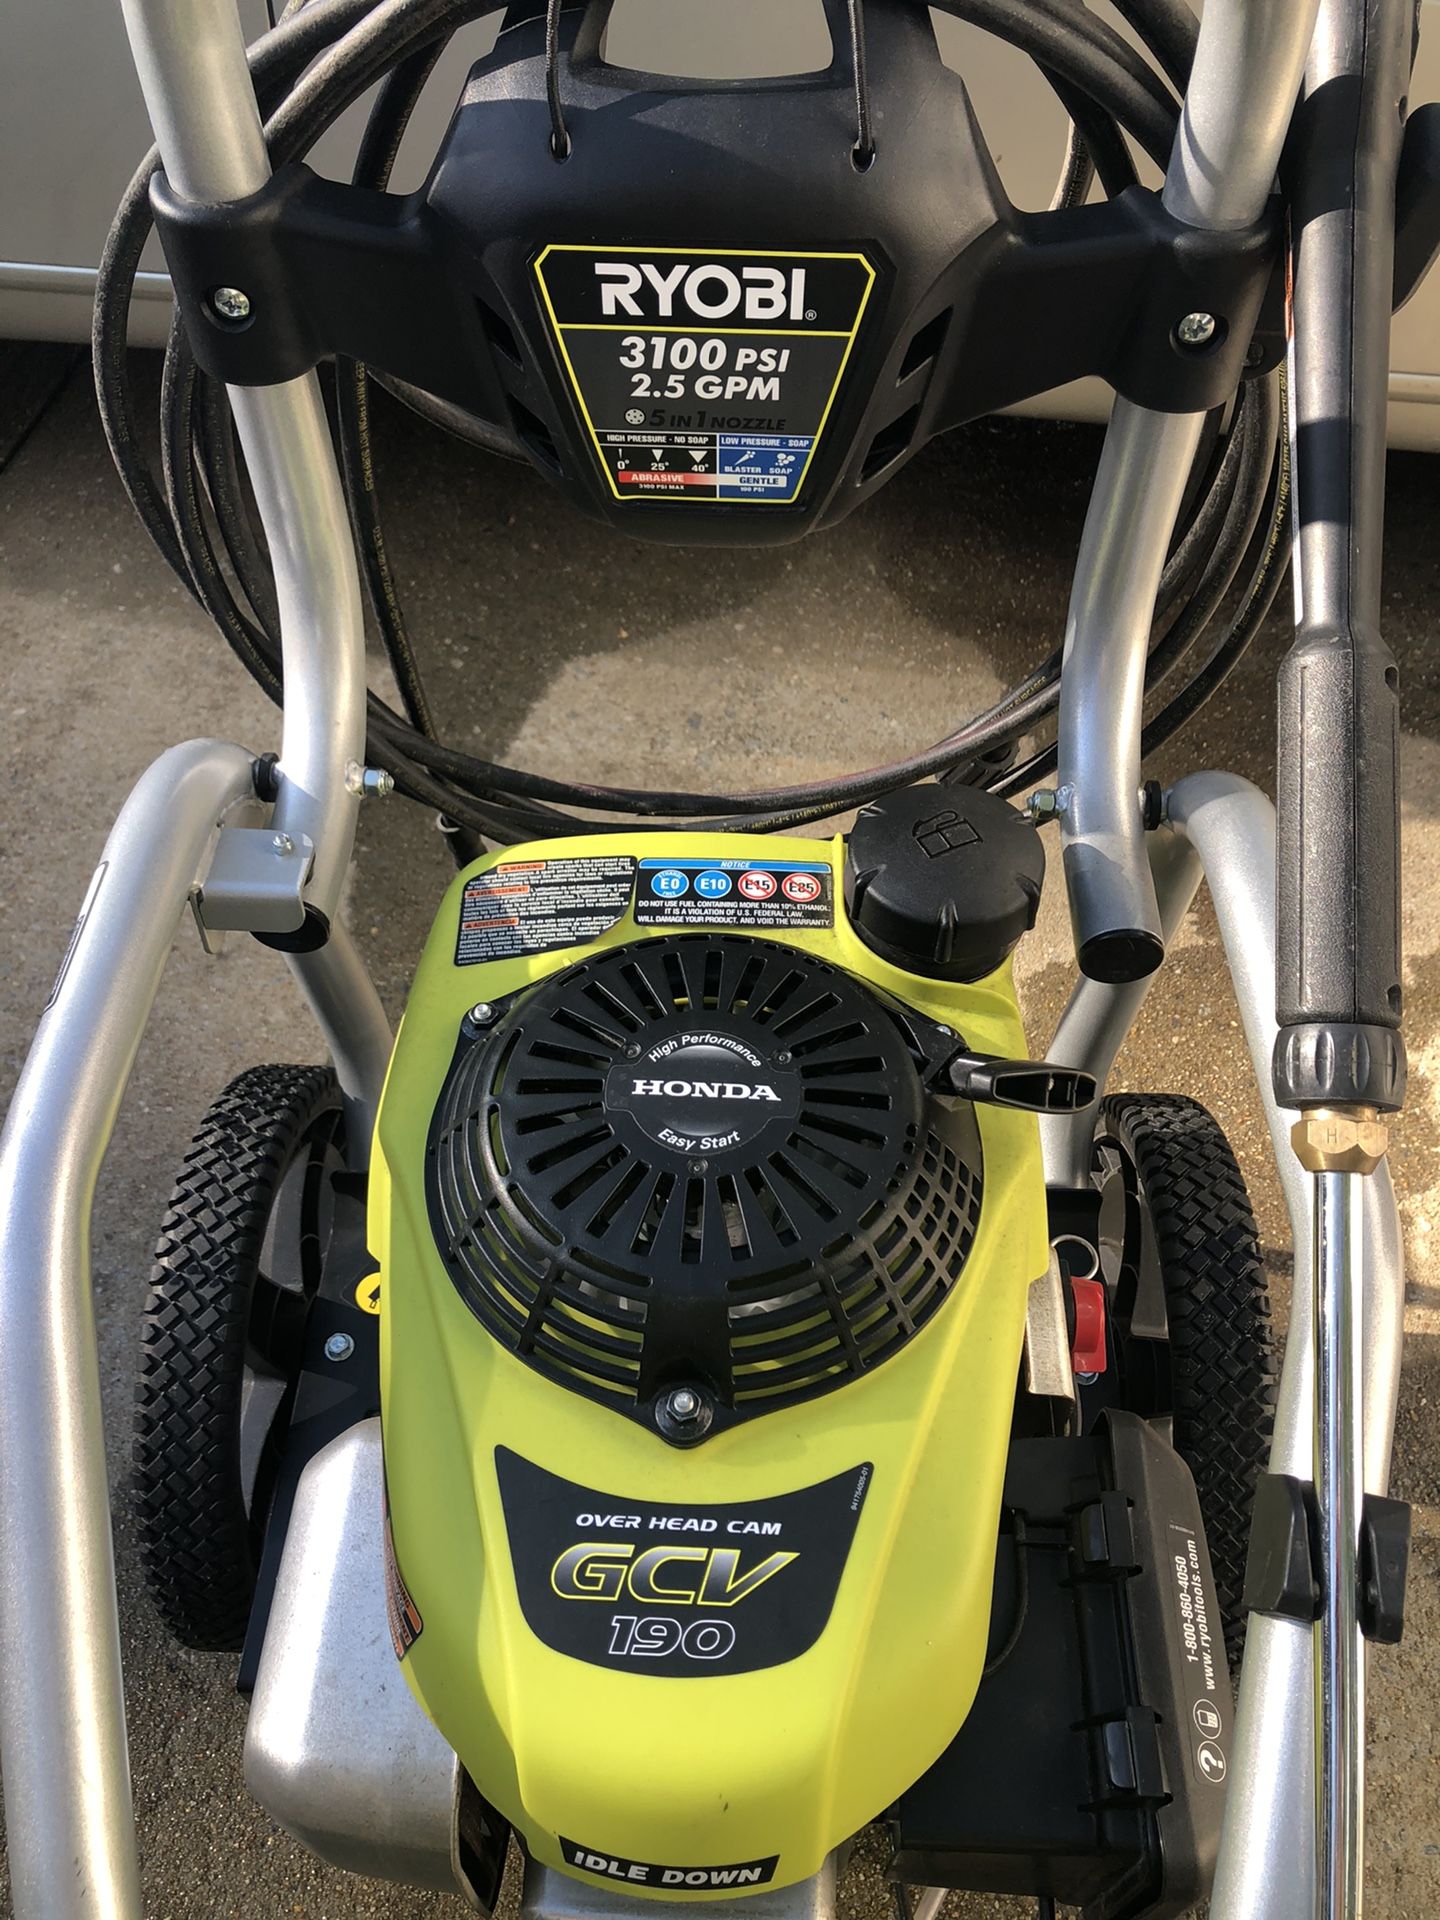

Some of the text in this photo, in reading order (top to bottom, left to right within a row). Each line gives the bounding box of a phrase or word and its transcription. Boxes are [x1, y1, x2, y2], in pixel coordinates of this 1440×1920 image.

[594, 262, 806, 320] RYOBI
[619, 335, 790, 373] 3100 PSI
[630, 373, 781, 401] 2.5 GPM
[650, 409, 786, 431] 5 IN 1 NOZZLE
[607, 434, 626, 442] HIGH
[628, 435, 667, 443] PRESSURE
[674, 436, 686, 444] NO
[688, 436, 709, 445] SOAP
[721, 437, 739, 445] LOW
[741, 437, 781, 447] PRESSURE
[788, 439, 810, 448] SOAP
[631, 473, 685, 483] ABRASIVE
[724, 466, 793, 475] BLASTER SOAP
[739, 476, 779, 485] GENTLE
[721, 861, 751, 869] NOTICE
[661, 878, 680, 889] E0
[700, 878, 726, 890] E10
[745, 880, 770, 891] E15
[688, 908, 725, 916] VIOLATION
[648, 1033, 762, 1068] High Performance
[631, 1079, 782, 1102] HONDA
[657, 1128, 741, 1151] Easy Start
[576, 1513, 782, 1536] OVER HEAD CAM
[551, 1542, 801, 1607] GCV
[1175, 1555, 1199, 1664] 1-800-860-4050
[1186, 1539, 1216, 1691] www.ryobitools.com
[608, 1615, 737, 1660] 190
[574, 1850, 763, 1885] IDLE DOWN
